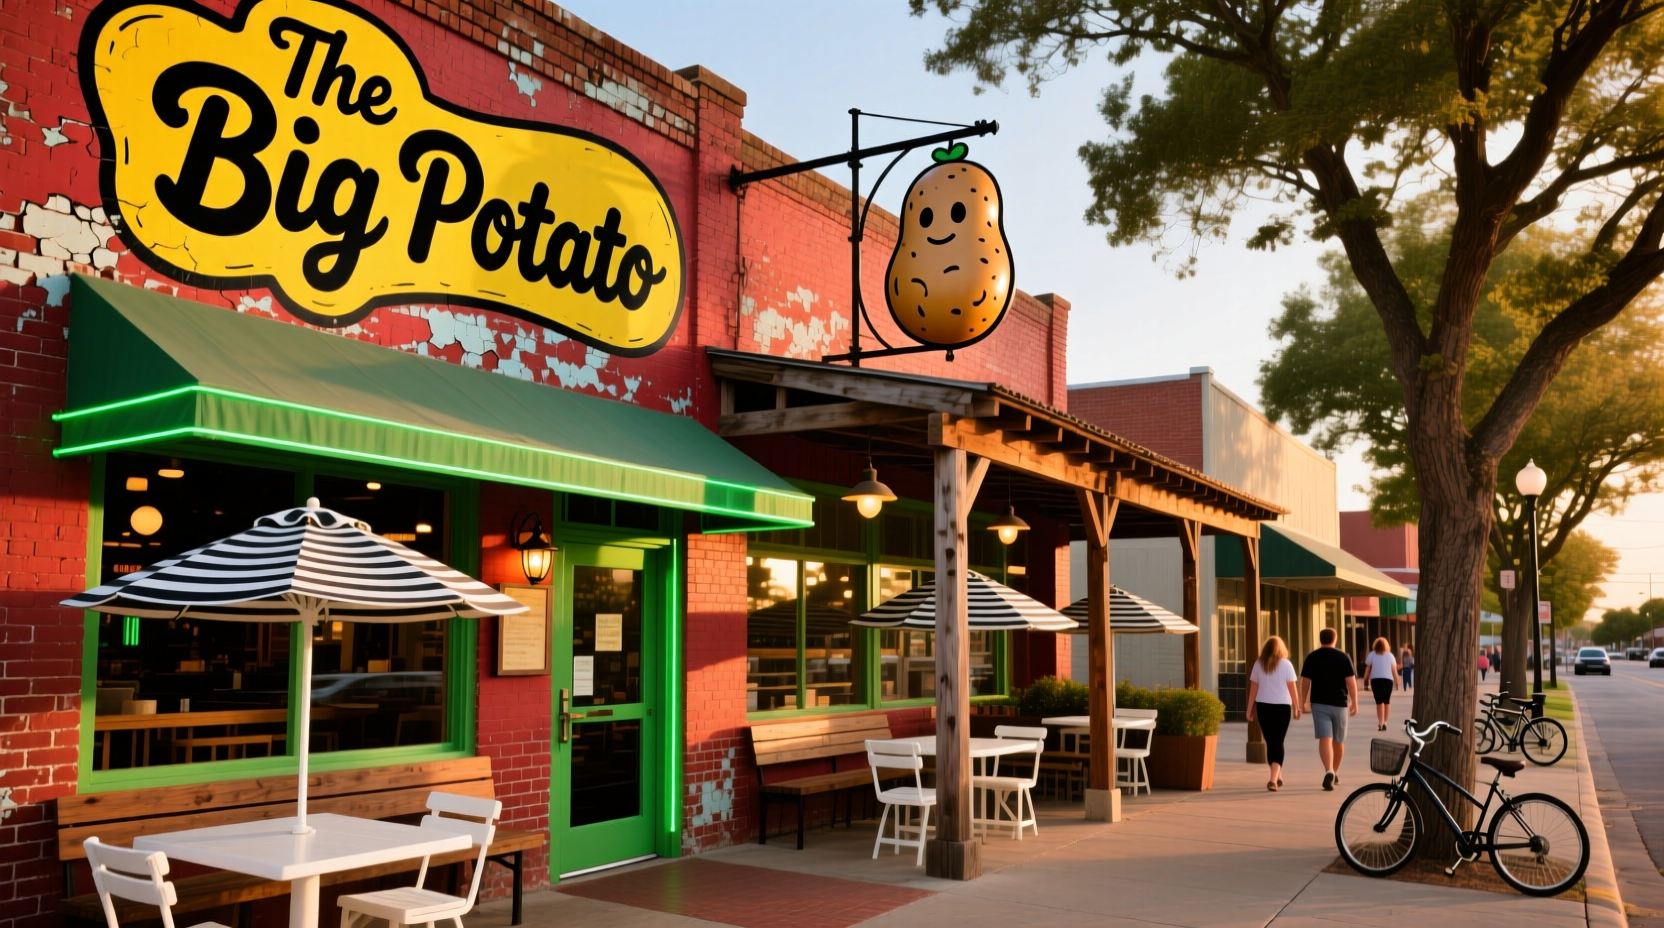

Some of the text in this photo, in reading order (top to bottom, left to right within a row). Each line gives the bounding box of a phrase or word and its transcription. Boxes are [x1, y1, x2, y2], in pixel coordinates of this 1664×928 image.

[268, 16, 398, 126] The
[152, 61, 666, 311] Big Potato
